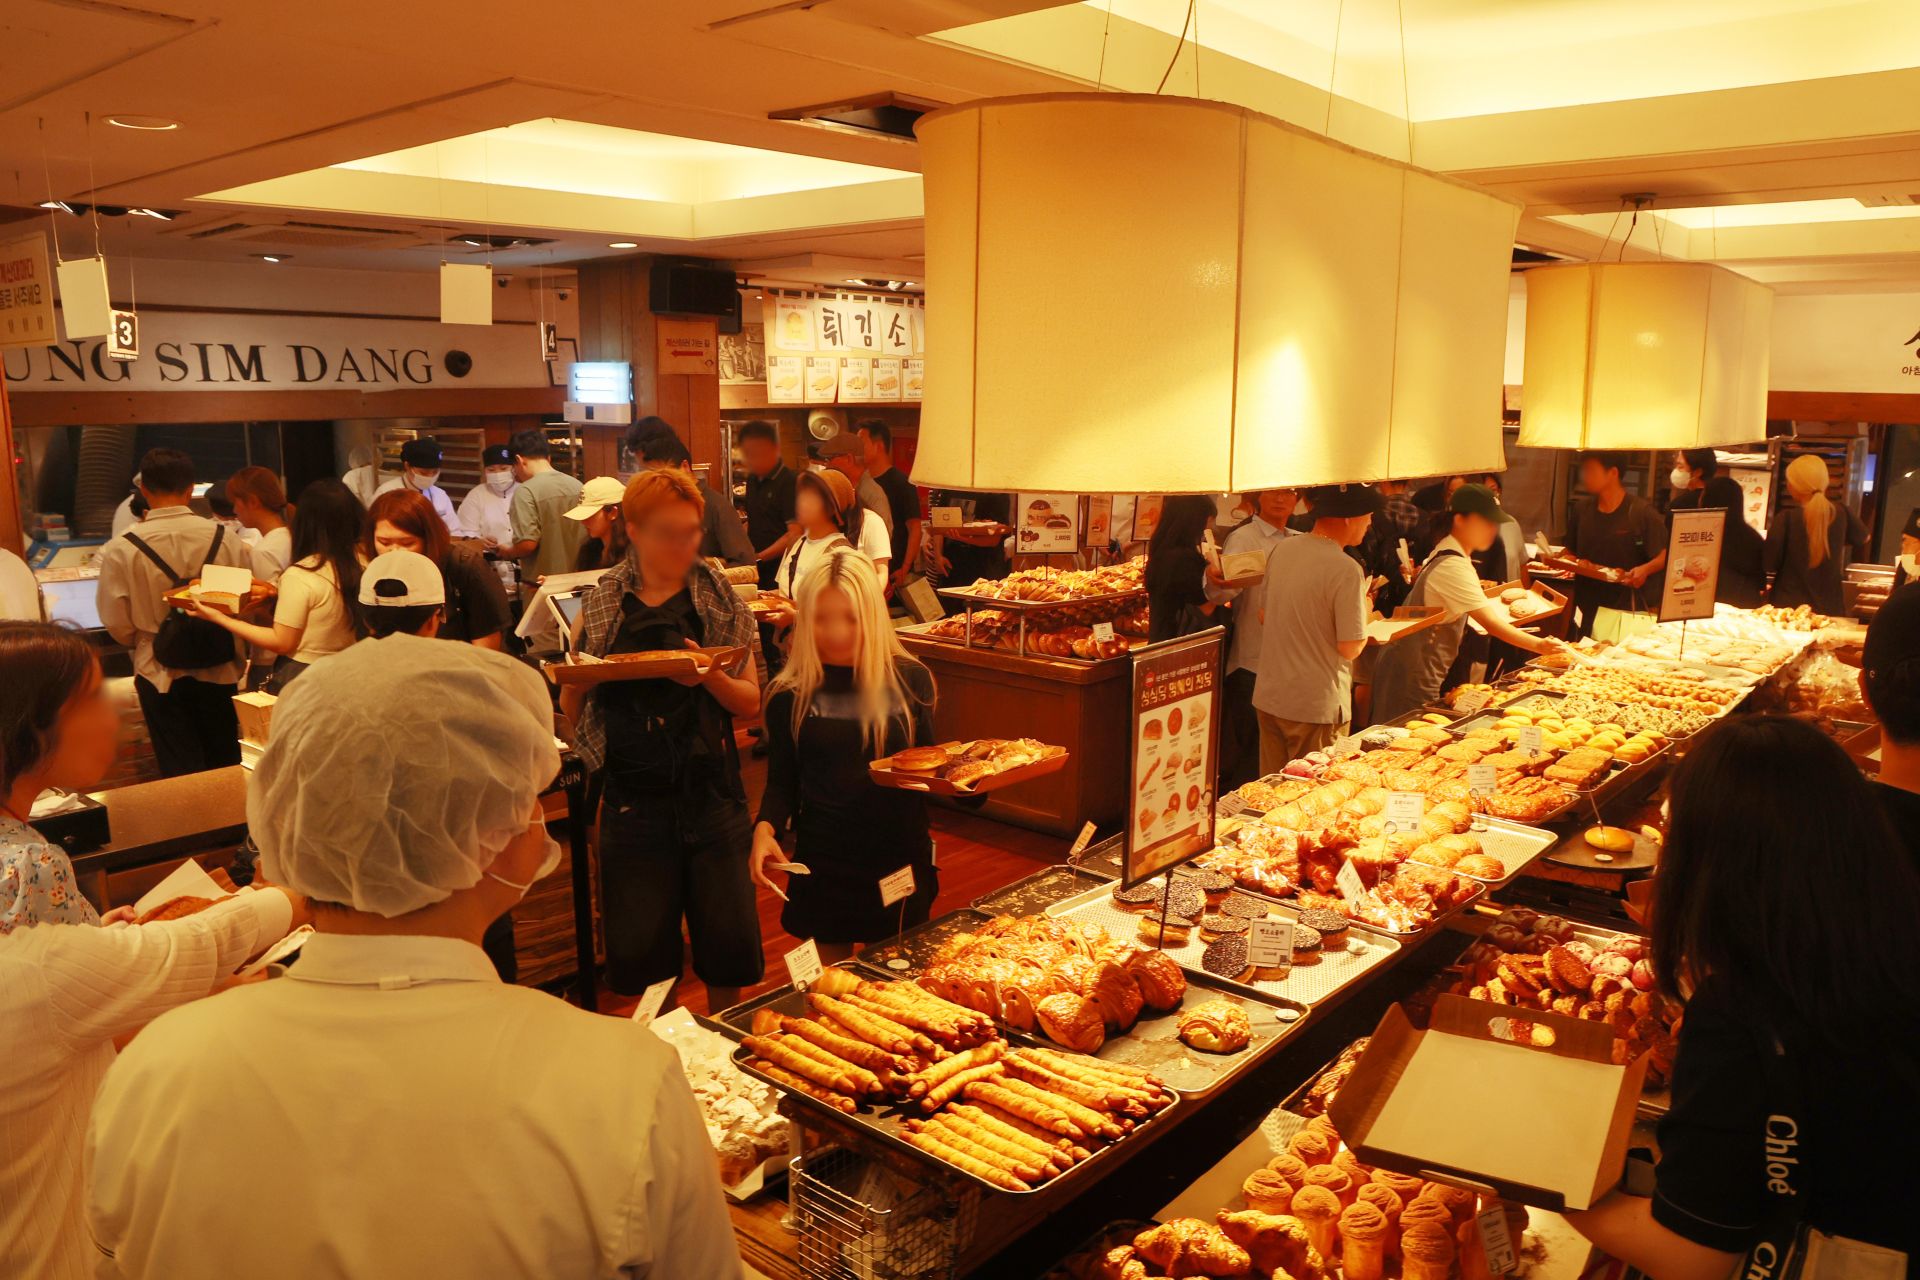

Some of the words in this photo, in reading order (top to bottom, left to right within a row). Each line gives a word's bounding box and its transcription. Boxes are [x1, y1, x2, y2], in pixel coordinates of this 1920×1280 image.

[119, 321, 132, 346] 3
[548, 330, 556, 349] 4
[822, 306, 906, 348] 튀김소
[155, 342, 270, 383] SIM
[287, 345, 433, 384] DANG
[1141, 685, 1167, 707] 성심당
[559, 771, 581, 788] SUN
[1765, 1114, 1799, 1196] Chloé
